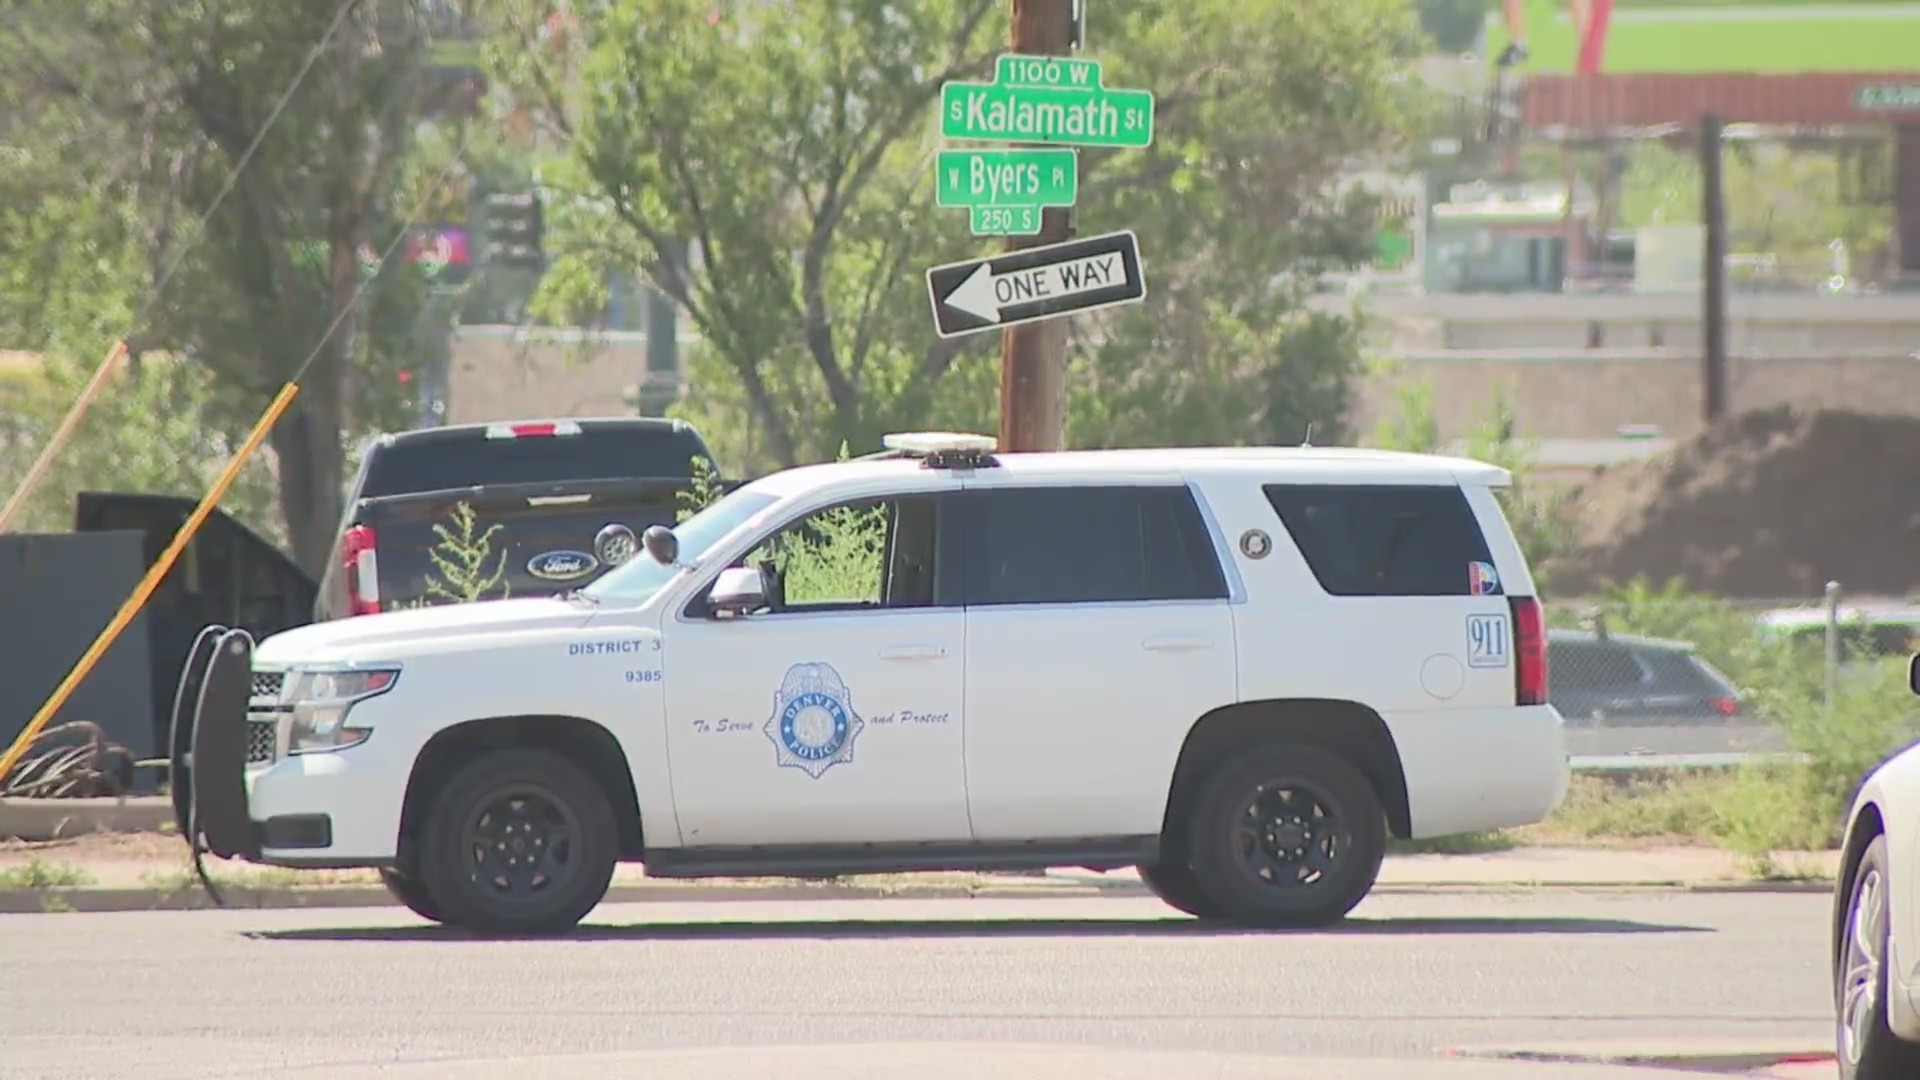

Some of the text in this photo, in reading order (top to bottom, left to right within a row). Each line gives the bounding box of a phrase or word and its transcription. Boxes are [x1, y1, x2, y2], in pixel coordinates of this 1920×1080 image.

[1009, 61, 1090, 85] 1100 W
[951, 91, 1144, 137] S Kalamath St
[948, 155, 1065, 204] W Byers Pl
[981, 209, 1032, 230] 250 S
[995, 255, 1115, 304] ONE WAY
[543, 556, 582, 573] Ford
[568, 638, 661, 656] DISTRICT 3
[1471, 617, 1503, 656] 911
[625, 670, 662, 683] 9385
[785, 694, 841, 719] DENVER
[692, 710, 949, 734] To Serve and Protect
[789, 738, 840, 759] POLICE
